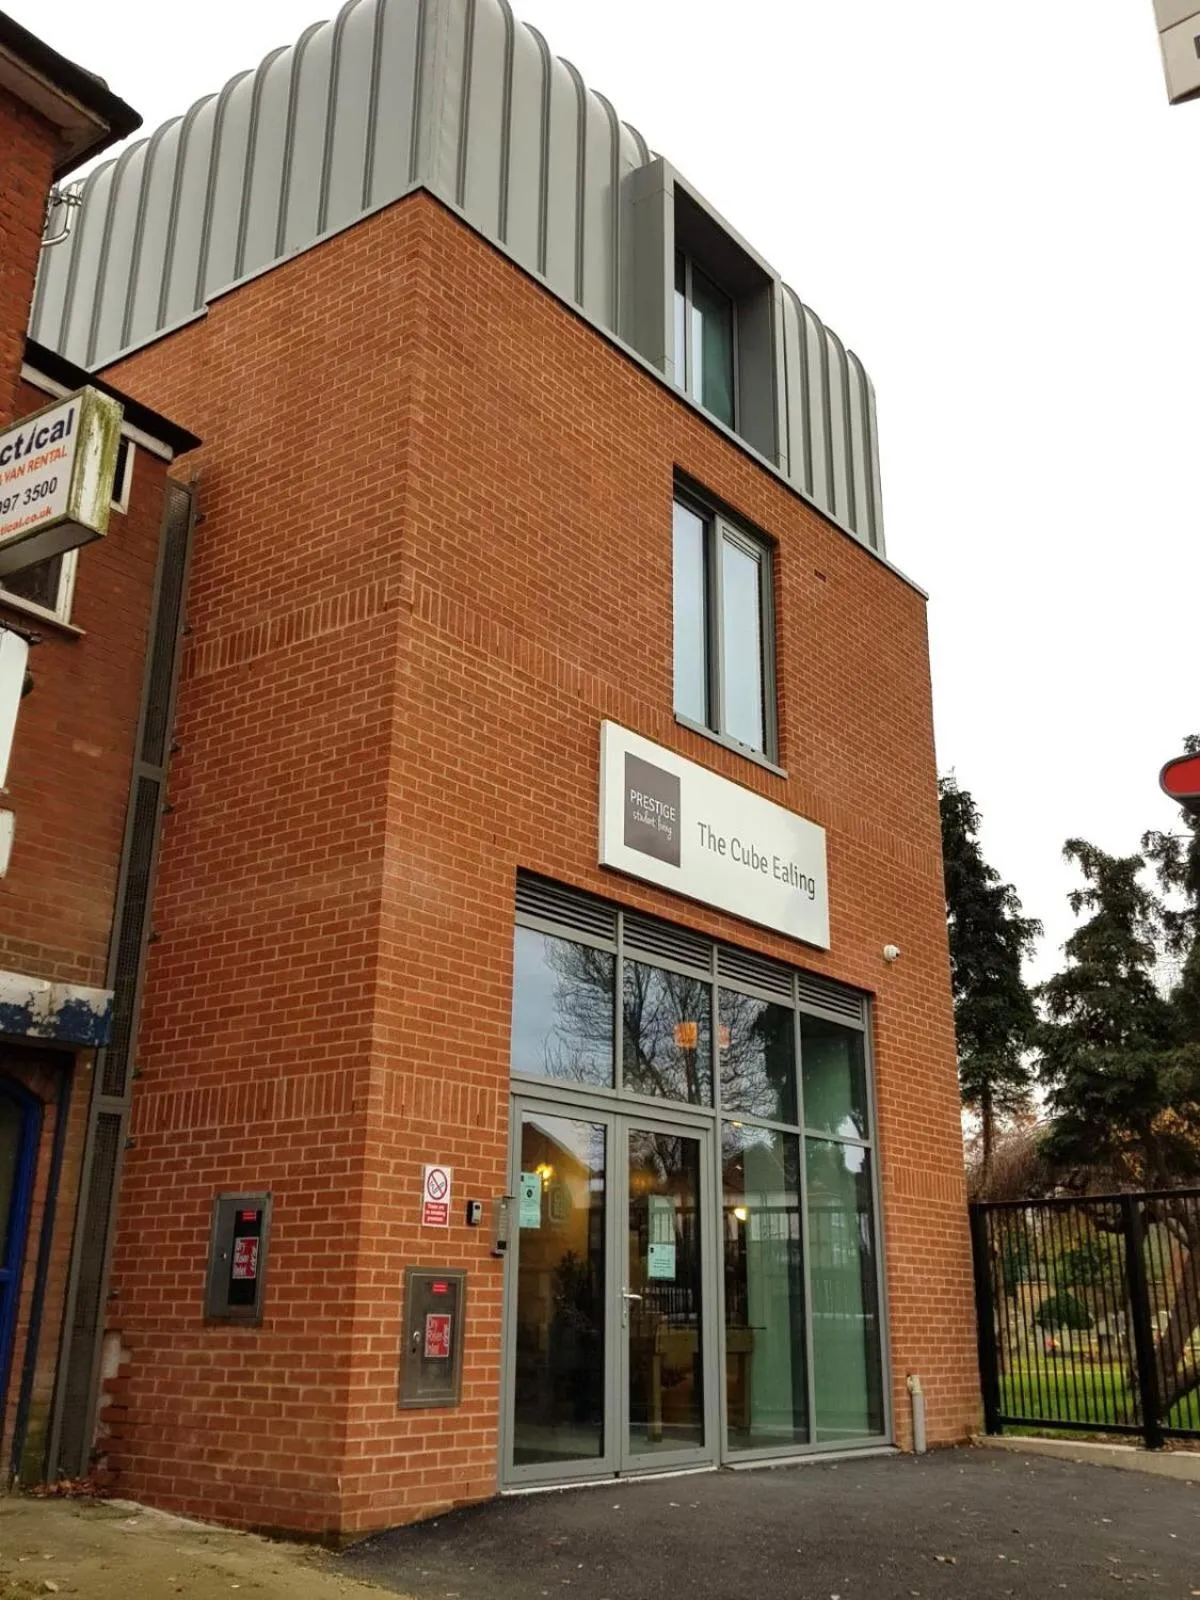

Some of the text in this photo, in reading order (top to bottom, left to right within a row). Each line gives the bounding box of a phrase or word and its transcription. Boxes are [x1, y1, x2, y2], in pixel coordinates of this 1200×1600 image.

[4, 463, 26, 483] VAN
[27, 444, 67, 474] RENTAL
[22, 476, 58, 506] 3500
[630, 788, 676, 822] PRESTIGE
[697, 821, 815, 901] The Cube Ealing
